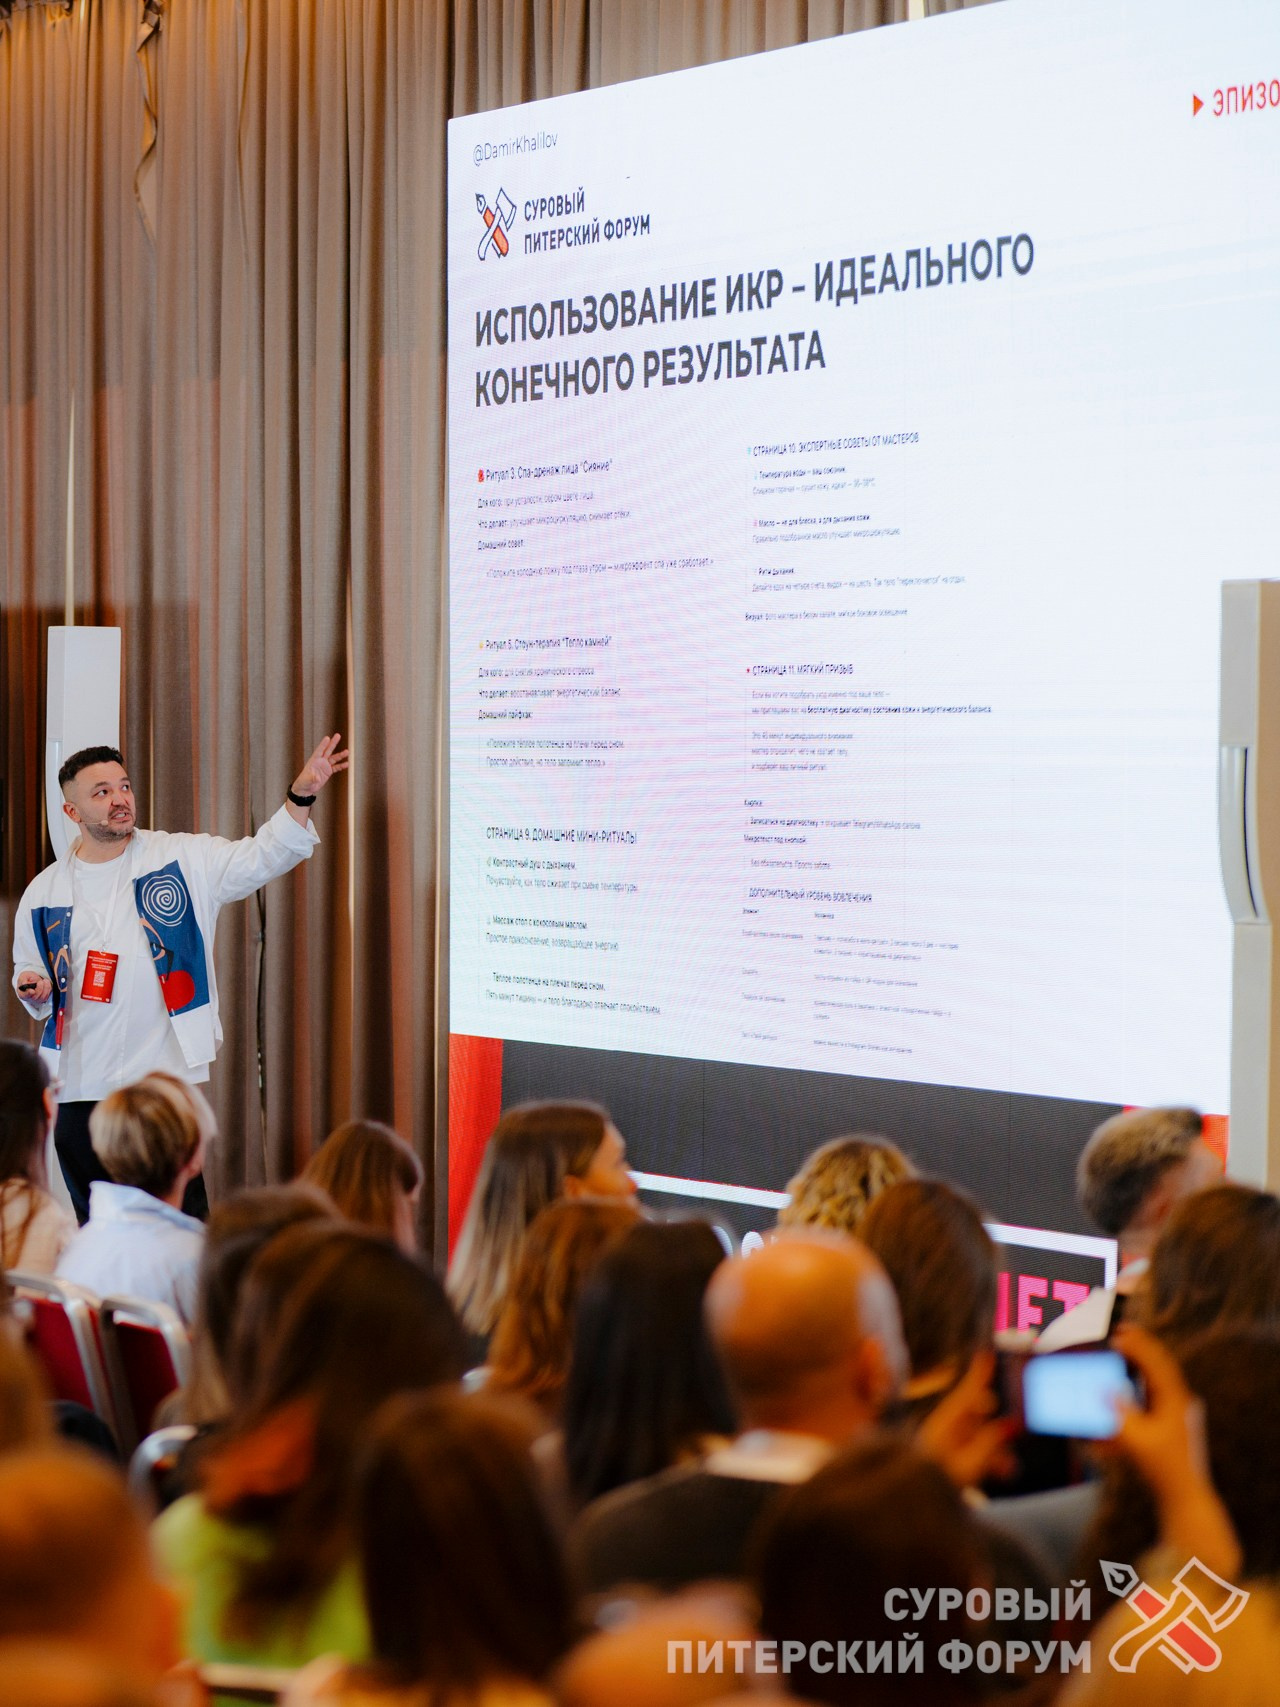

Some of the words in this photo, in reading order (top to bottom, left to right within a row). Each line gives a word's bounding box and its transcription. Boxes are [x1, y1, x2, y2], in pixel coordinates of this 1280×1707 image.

[473, 132, 558, 166] @DamirKhalilov
[524, 187, 585, 221] СУРОВЫЙ
[524, 219, 600, 254] ПИТЕРСКИЙ
[604, 214, 650, 242] ФОРУМ
[475, 277, 717, 347] ИСПОЛЬЗОВАНИЕ
[725, 268, 783, 314] ИКР
[815, 233, 1034, 307] ИДЕАЛЬНОГО
[475, 352, 635, 408] КОНЕЧНОГО
[643, 330, 826, 388] РЕЗУЛЬТАТА
[486, 827, 523, 840] СТРАНИЦА
[532, 828, 575, 842] ДОМАШНИЕ
